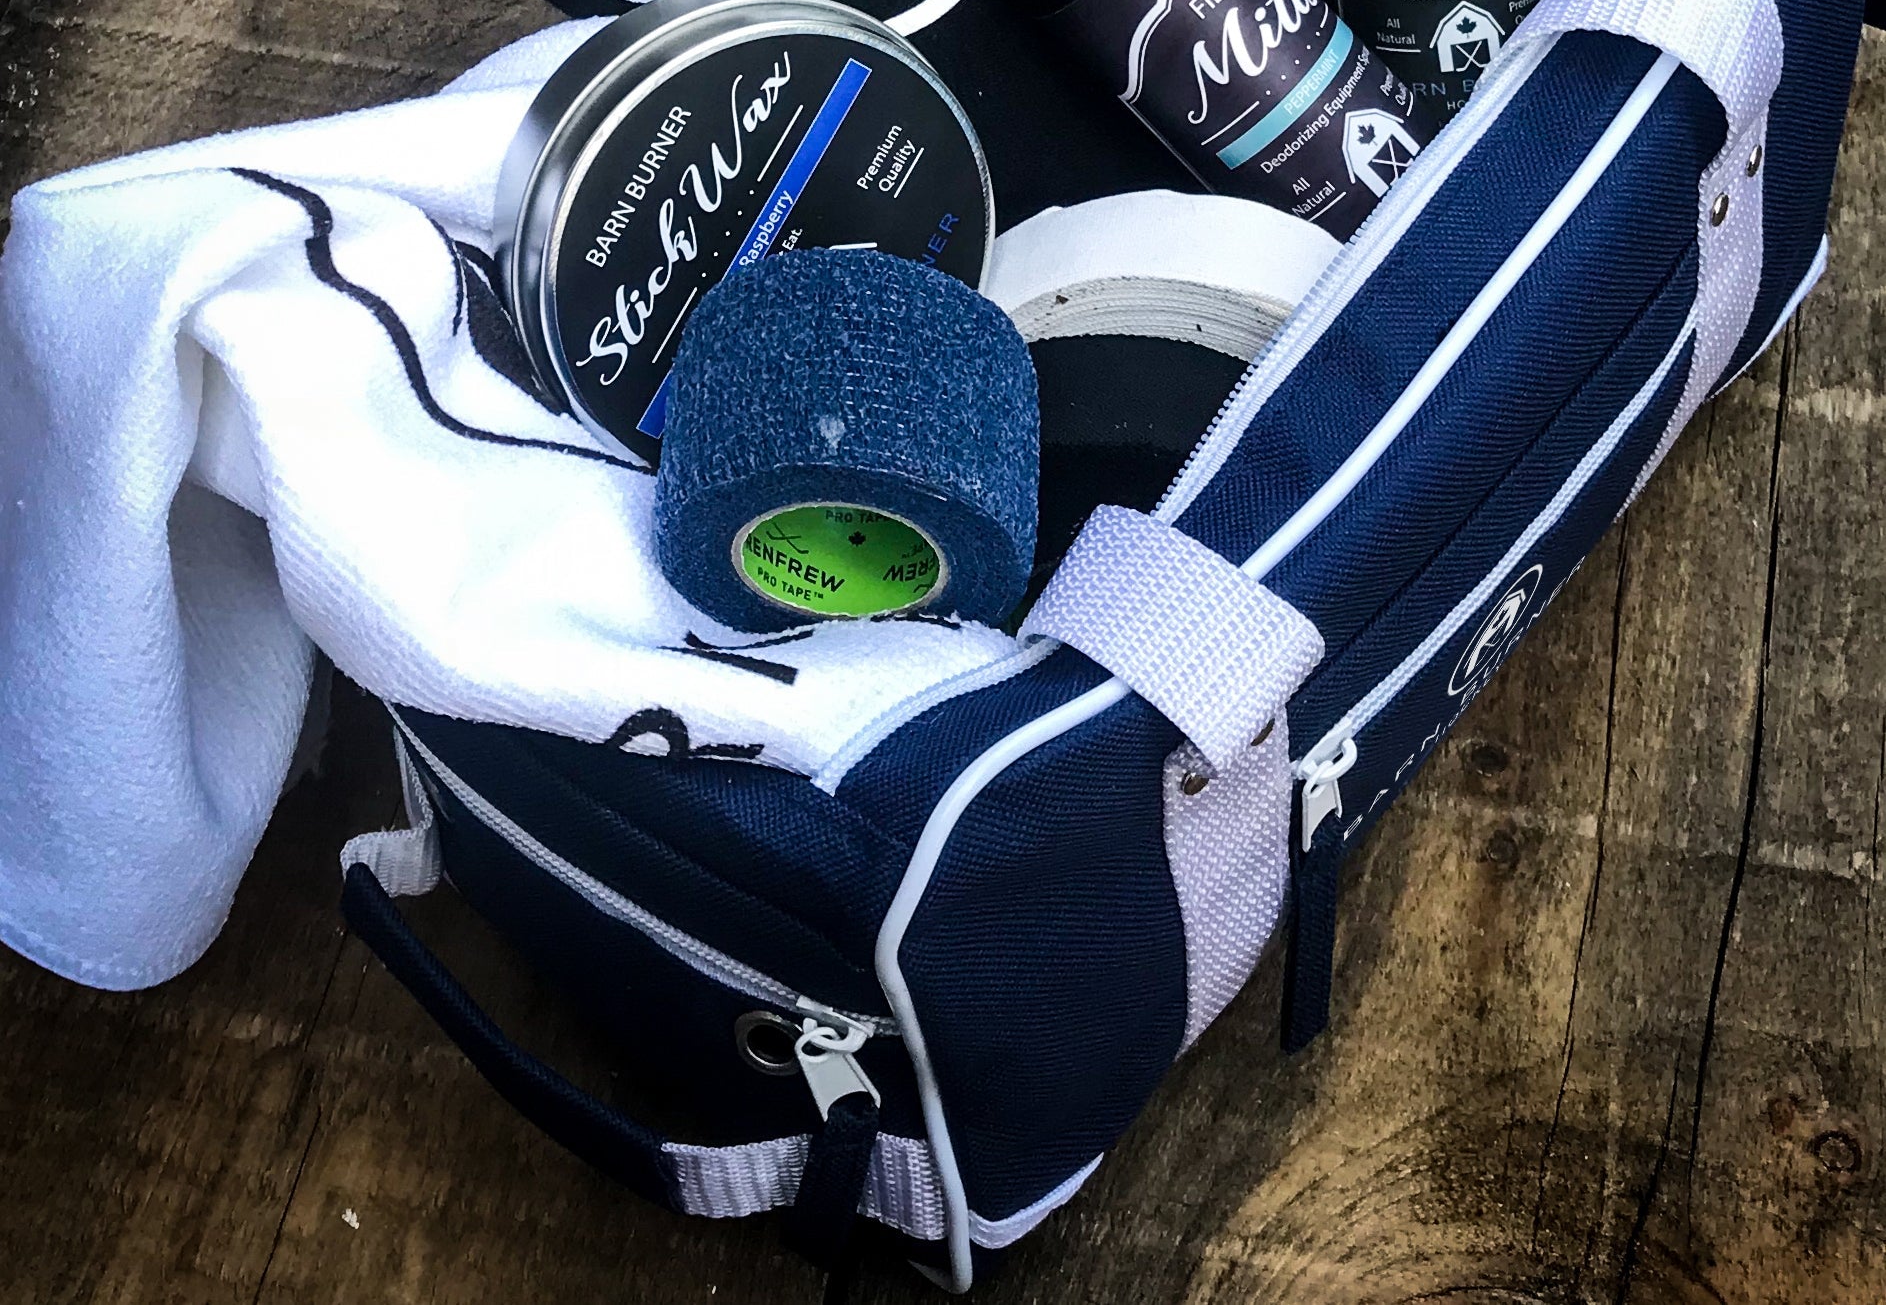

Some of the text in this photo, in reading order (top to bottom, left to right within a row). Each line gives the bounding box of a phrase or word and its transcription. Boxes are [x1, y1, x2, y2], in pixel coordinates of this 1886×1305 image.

[1376, 31, 1416, 45] Natural
[1386, 17, 1401, 29] All
[1284, 48, 1341, 115] PEPPERMINT
[1260, 113, 1330, 174] Deodorizing
[1323, 62, 1365, 116] Equipment
[856, 124, 902, 191] Premium
[877, 138, 918, 194] Quality
[584, 105, 692, 270] BARN BURNER
[1291, 176, 1311, 196] All
[1291, 180, 1336, 217] Natural
[575, 51, 792, 386] Stick Wax
[739, 189, 793, 268] Raspberry
[825, 509, 853, 523] PRO
[757, 566, 777, 588] PRO
